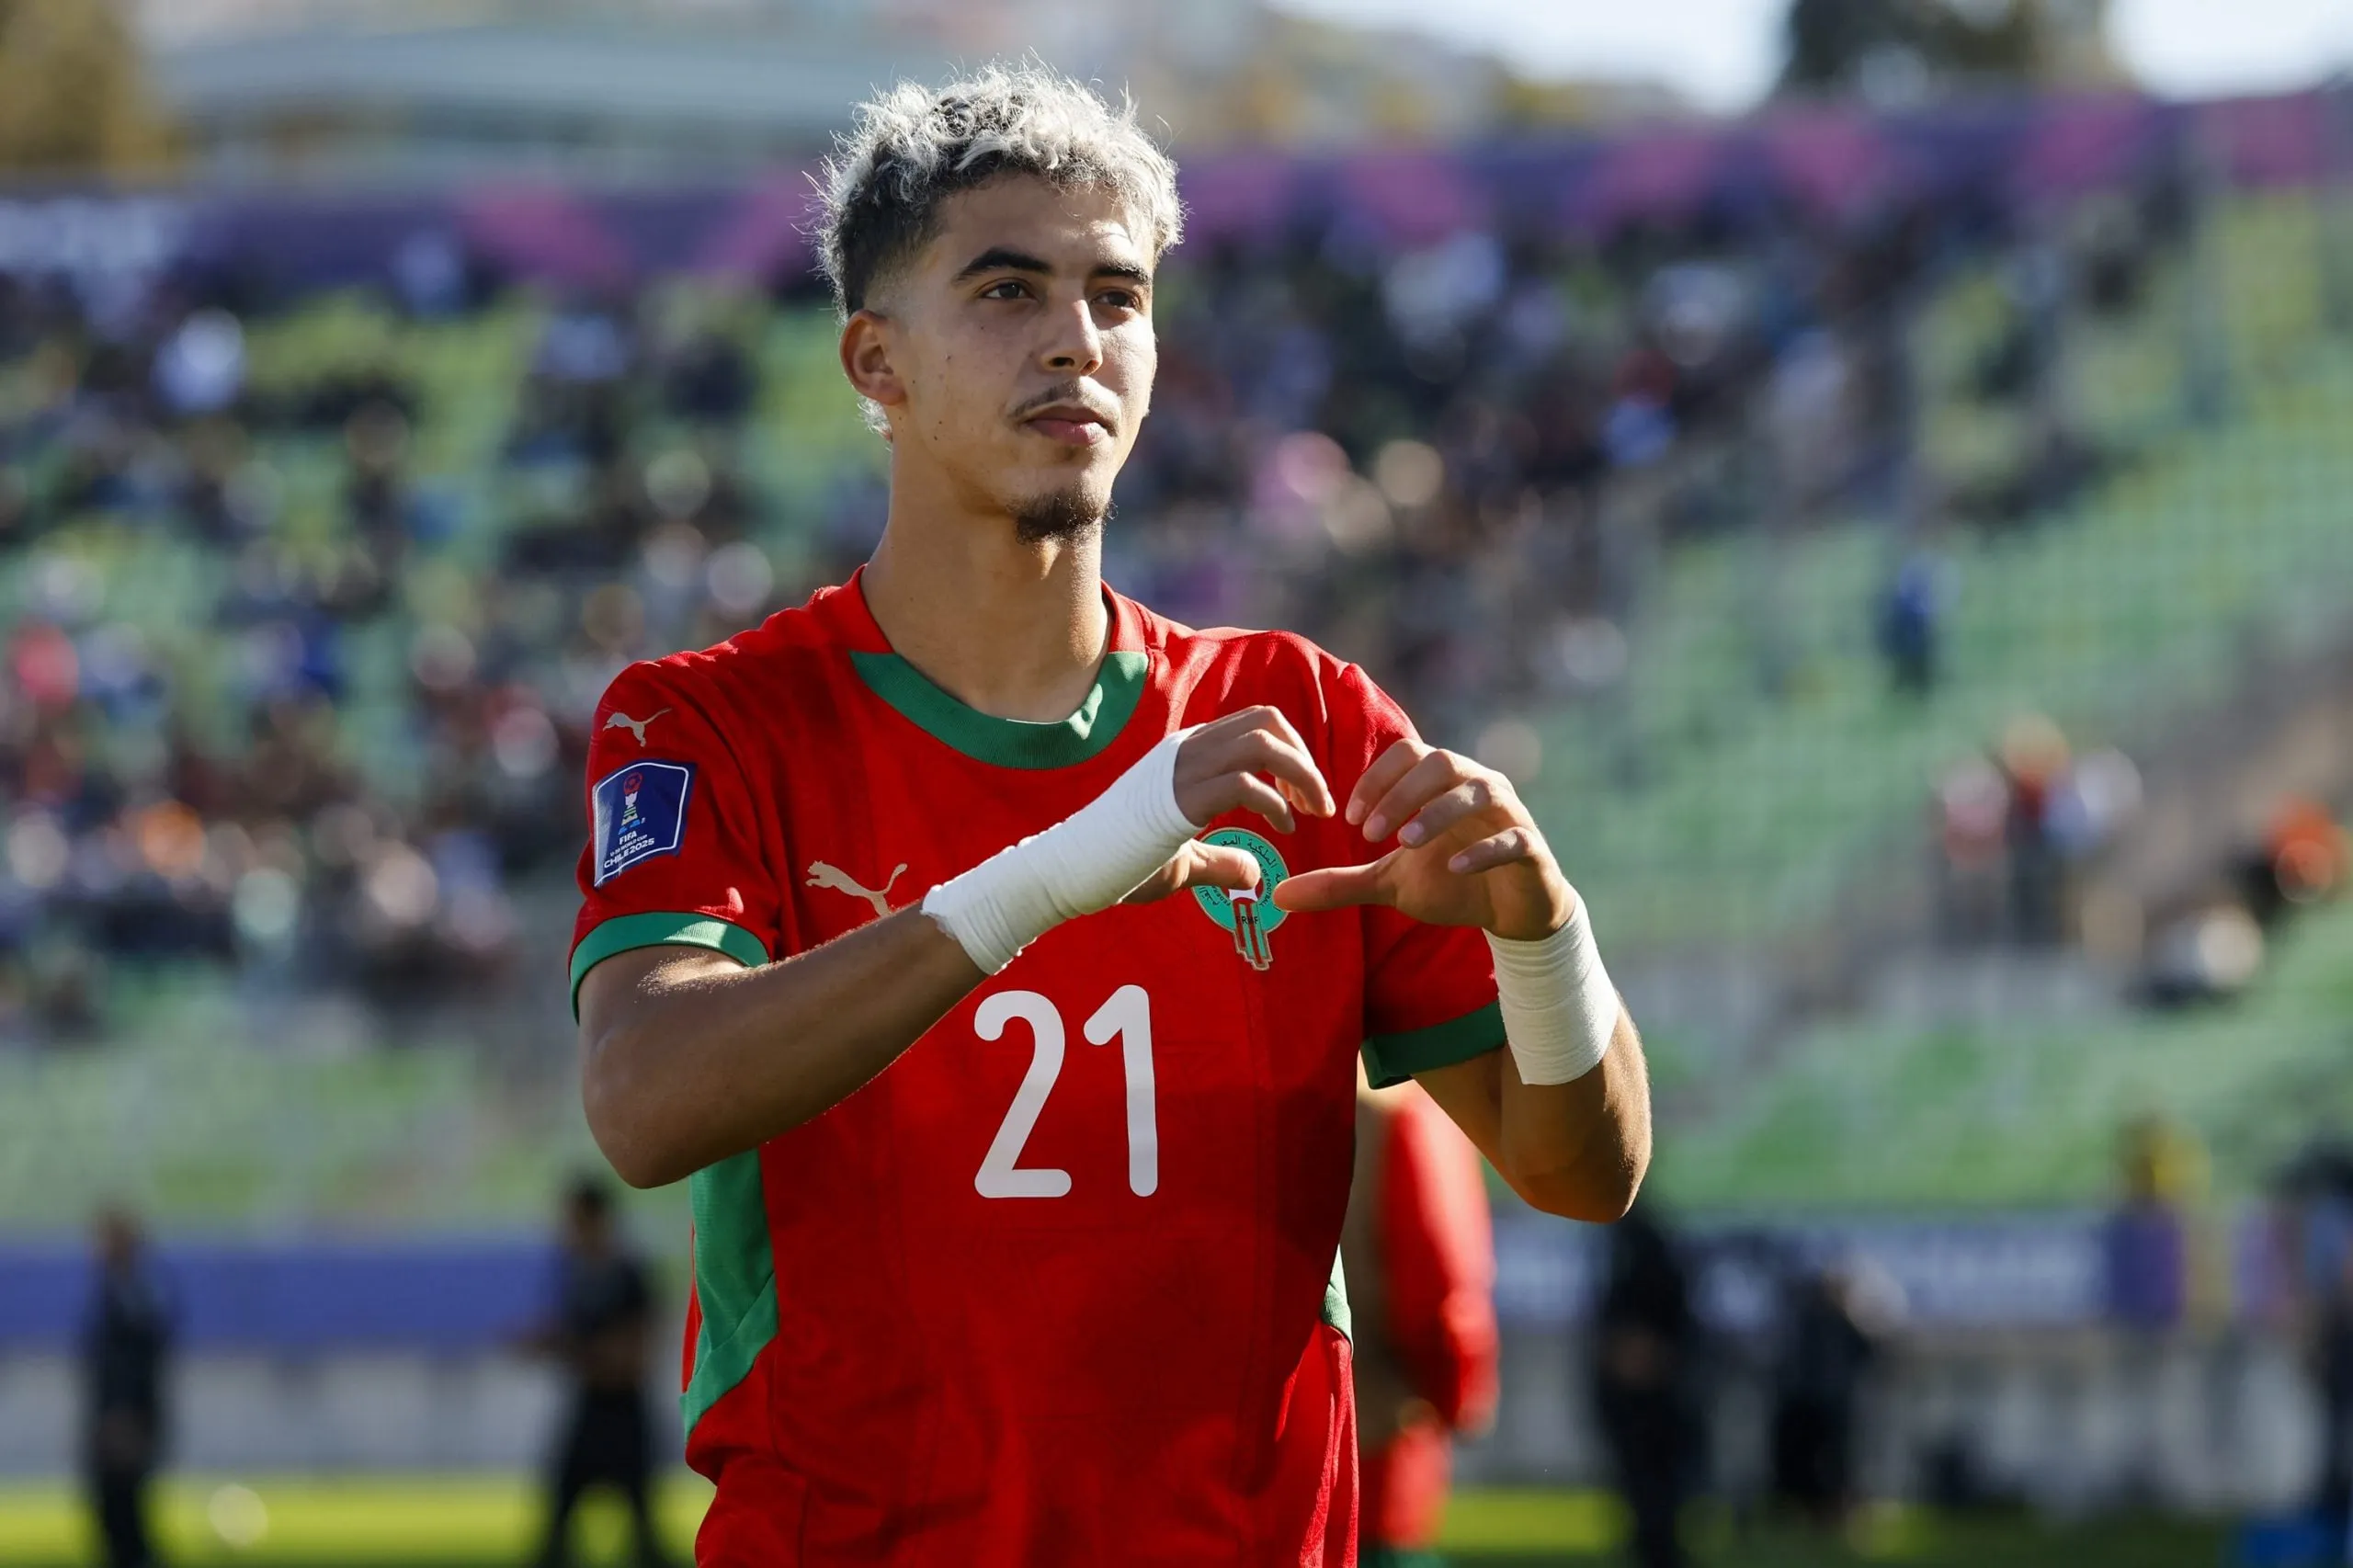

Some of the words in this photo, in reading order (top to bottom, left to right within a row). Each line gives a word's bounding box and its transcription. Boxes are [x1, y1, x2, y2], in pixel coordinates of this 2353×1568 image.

[620, 830, 637, 845] FIFA
[620, 838, 637, 850] WORLD
[637, 834, 647, 842] CUP
[974, 984, 1158, 1199] 21
